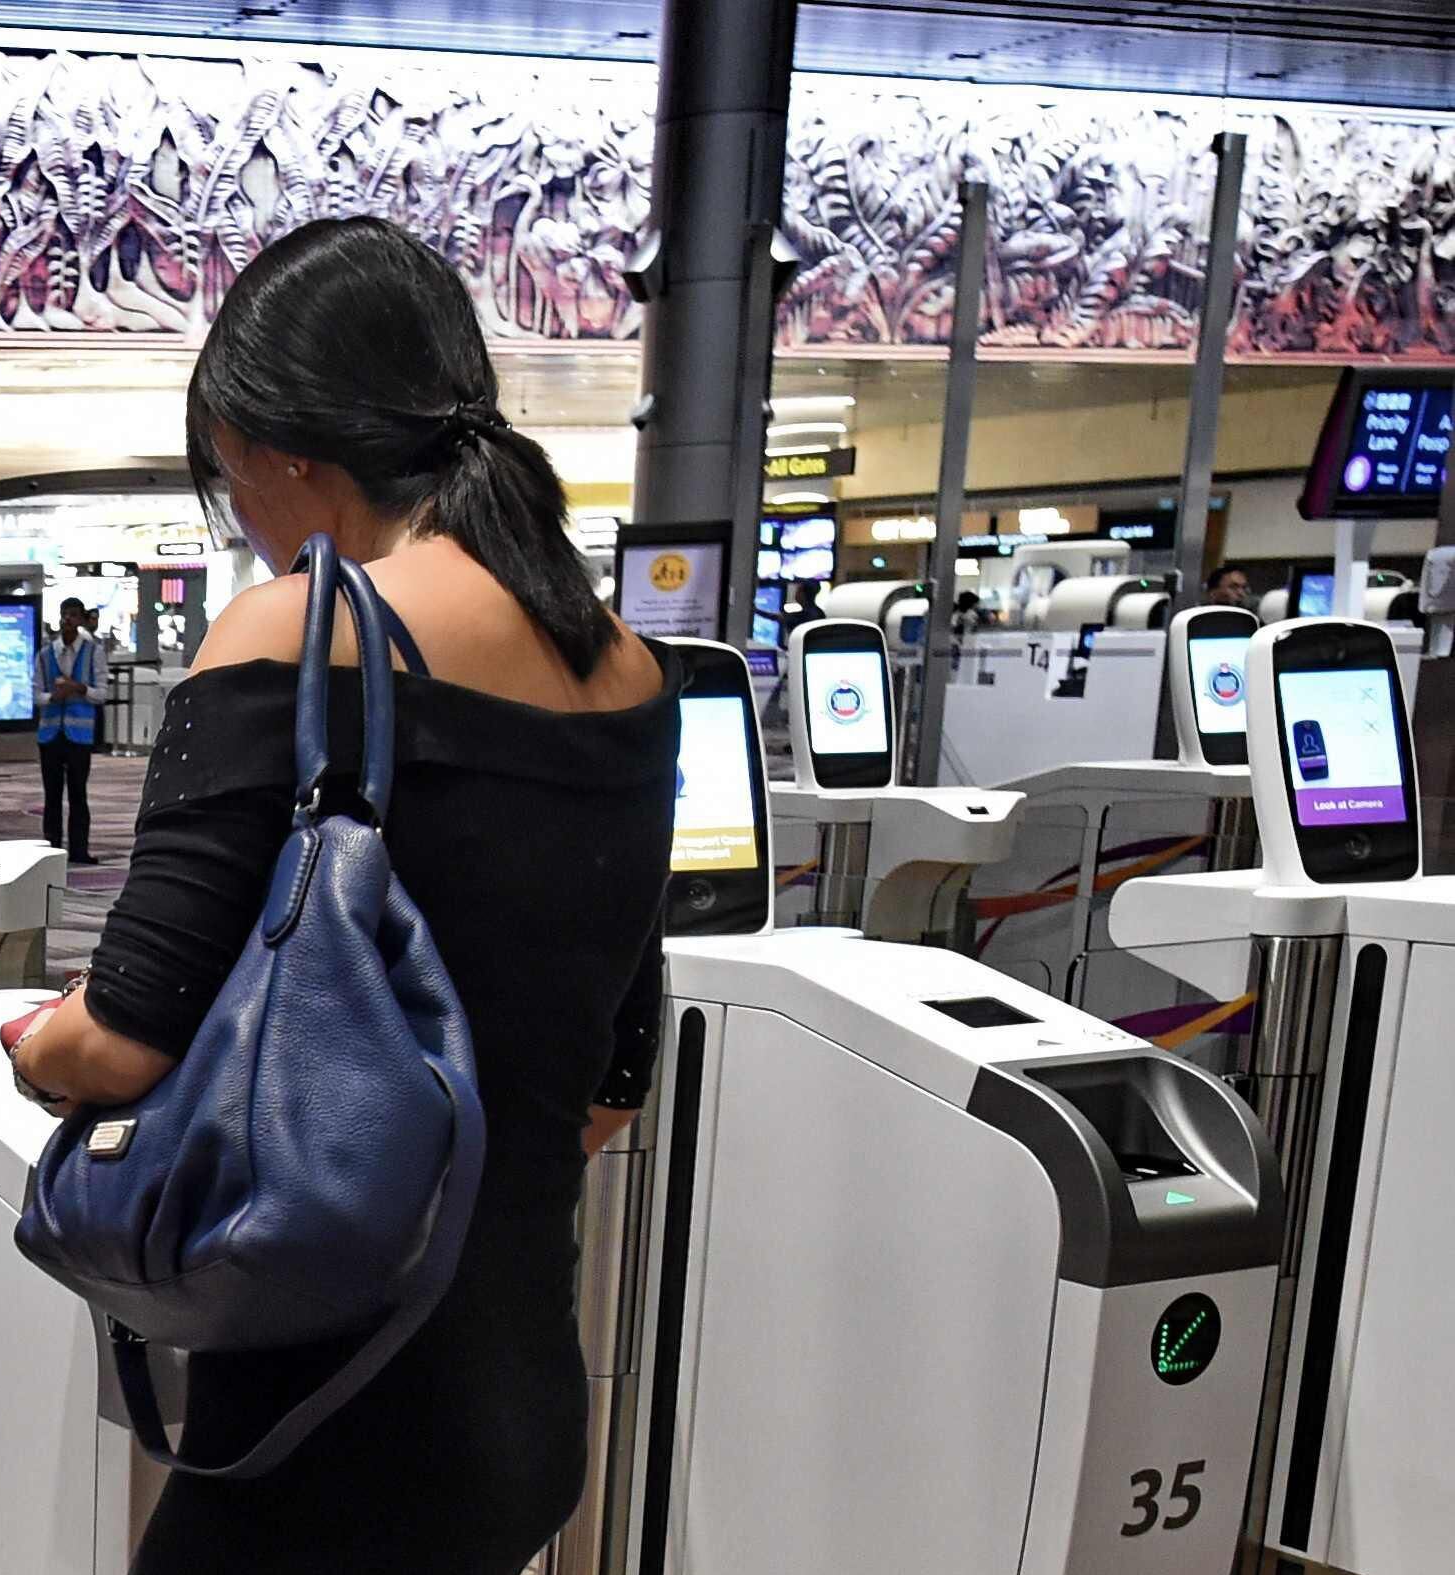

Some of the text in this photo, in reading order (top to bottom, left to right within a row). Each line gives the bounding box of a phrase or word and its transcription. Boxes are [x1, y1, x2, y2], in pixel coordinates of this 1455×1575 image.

[1028, 643, 1049, 672] T4
[1313, 800, 1384, 811] Look at Camera
[1119, 1458, 1207, 1539] 35
